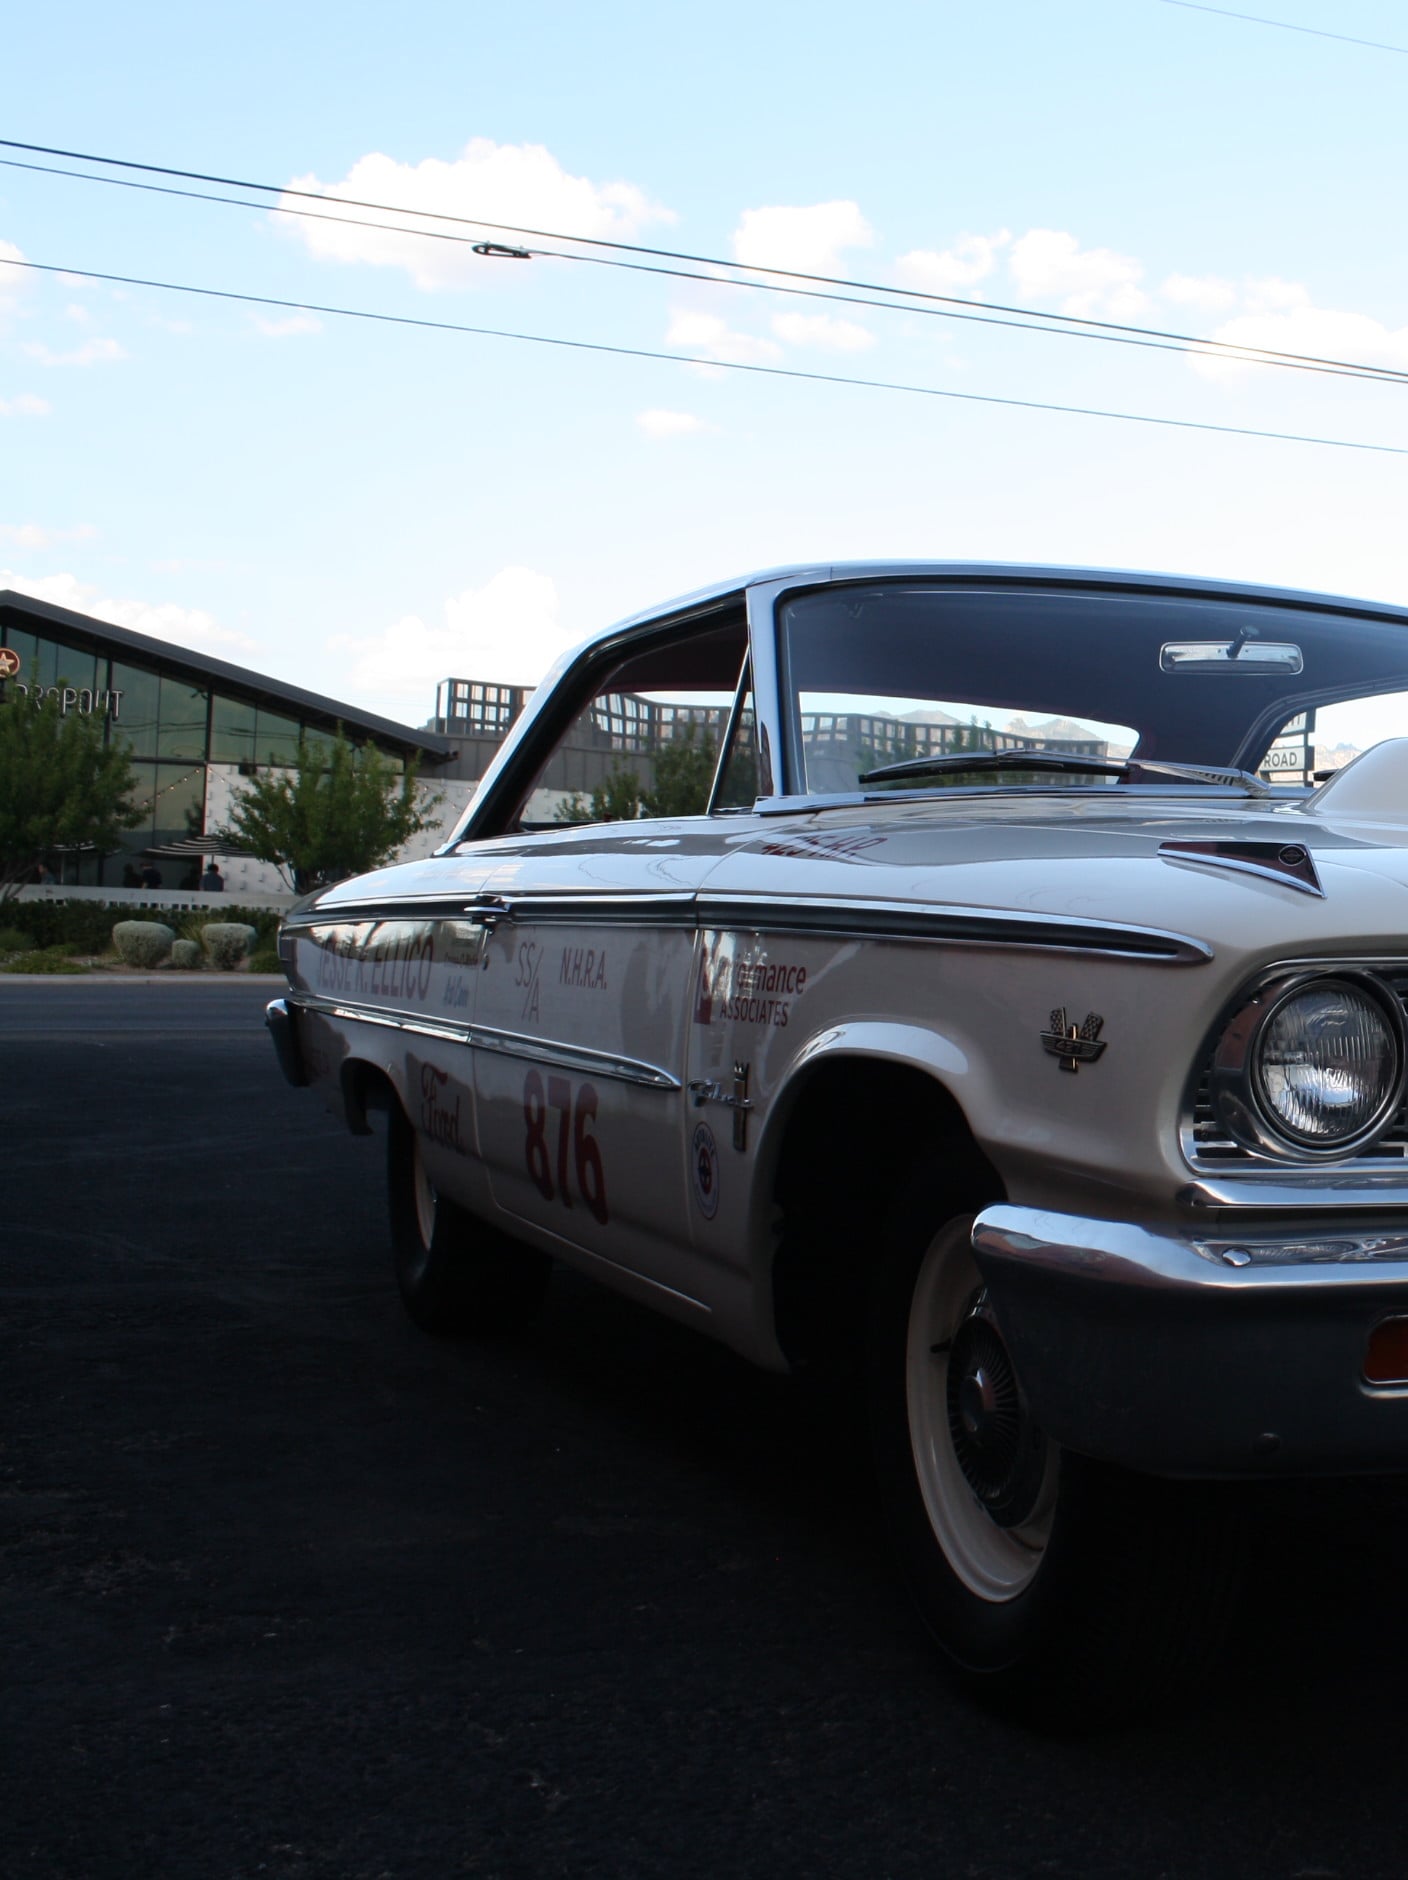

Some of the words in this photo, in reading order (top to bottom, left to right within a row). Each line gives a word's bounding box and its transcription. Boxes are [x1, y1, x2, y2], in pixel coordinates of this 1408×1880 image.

[1264, 752, 1297, 768] ROAD
[720, 997, 789, 1027] ASSOCIATES
[524, 1068, 609, 1226] 876
